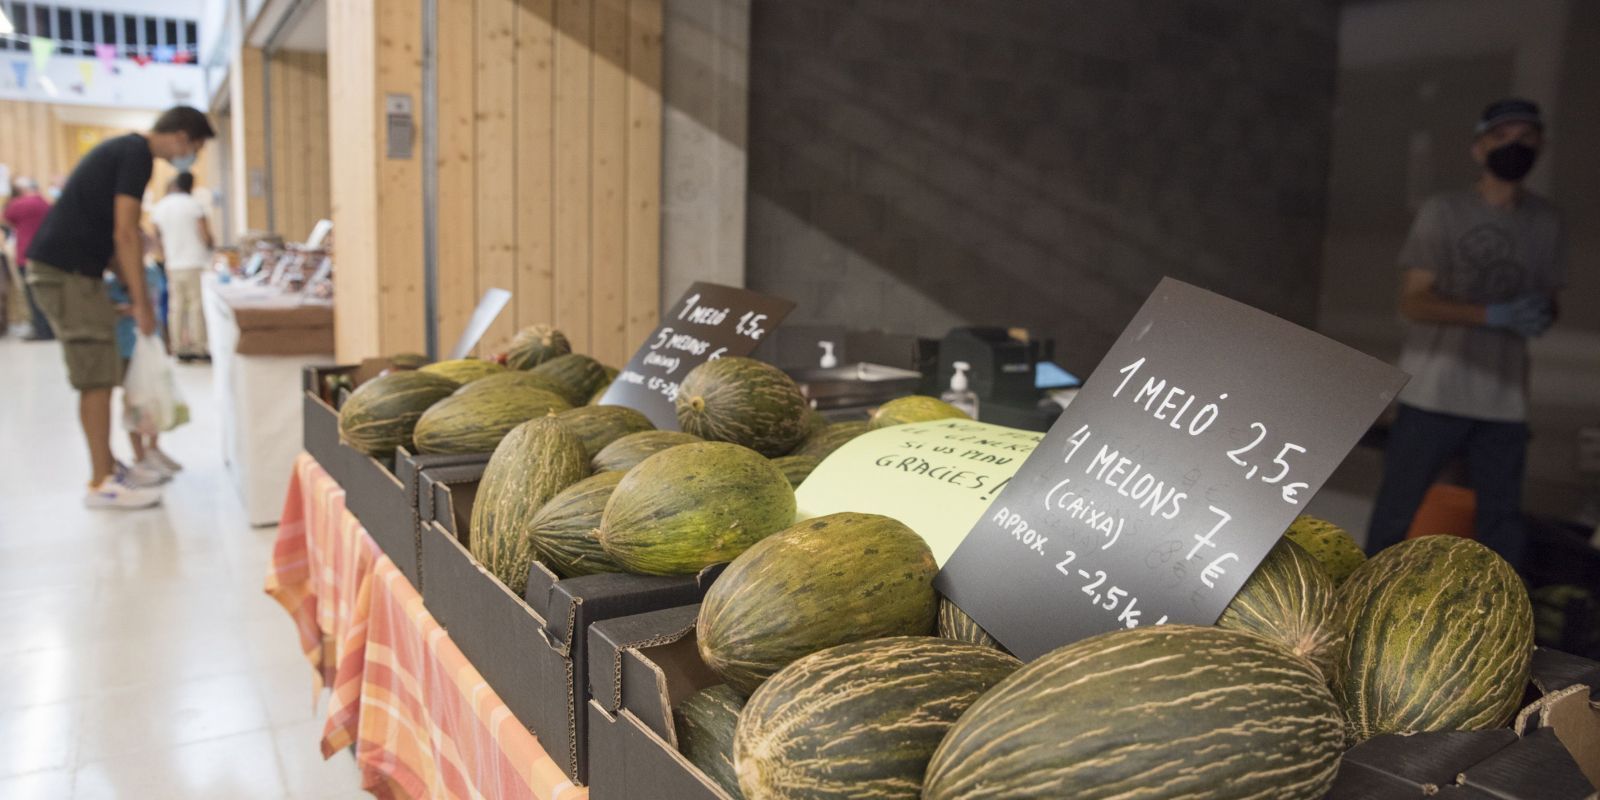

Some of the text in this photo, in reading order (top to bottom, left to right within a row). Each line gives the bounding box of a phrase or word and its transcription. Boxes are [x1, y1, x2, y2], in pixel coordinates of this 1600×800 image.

[678, 293, 700, 320] 1
[650, 327, 674, 350] 5
[1112, 357, 1146, 398] 1
[1133, 376, 1228, 436] MELÓ
[932, 445, 954, 454] US
[1064, 424, 1092, 464] 4
[1085, 444, 1188, 520] MELONS
[993, 506, 1049, 556] APROX.
